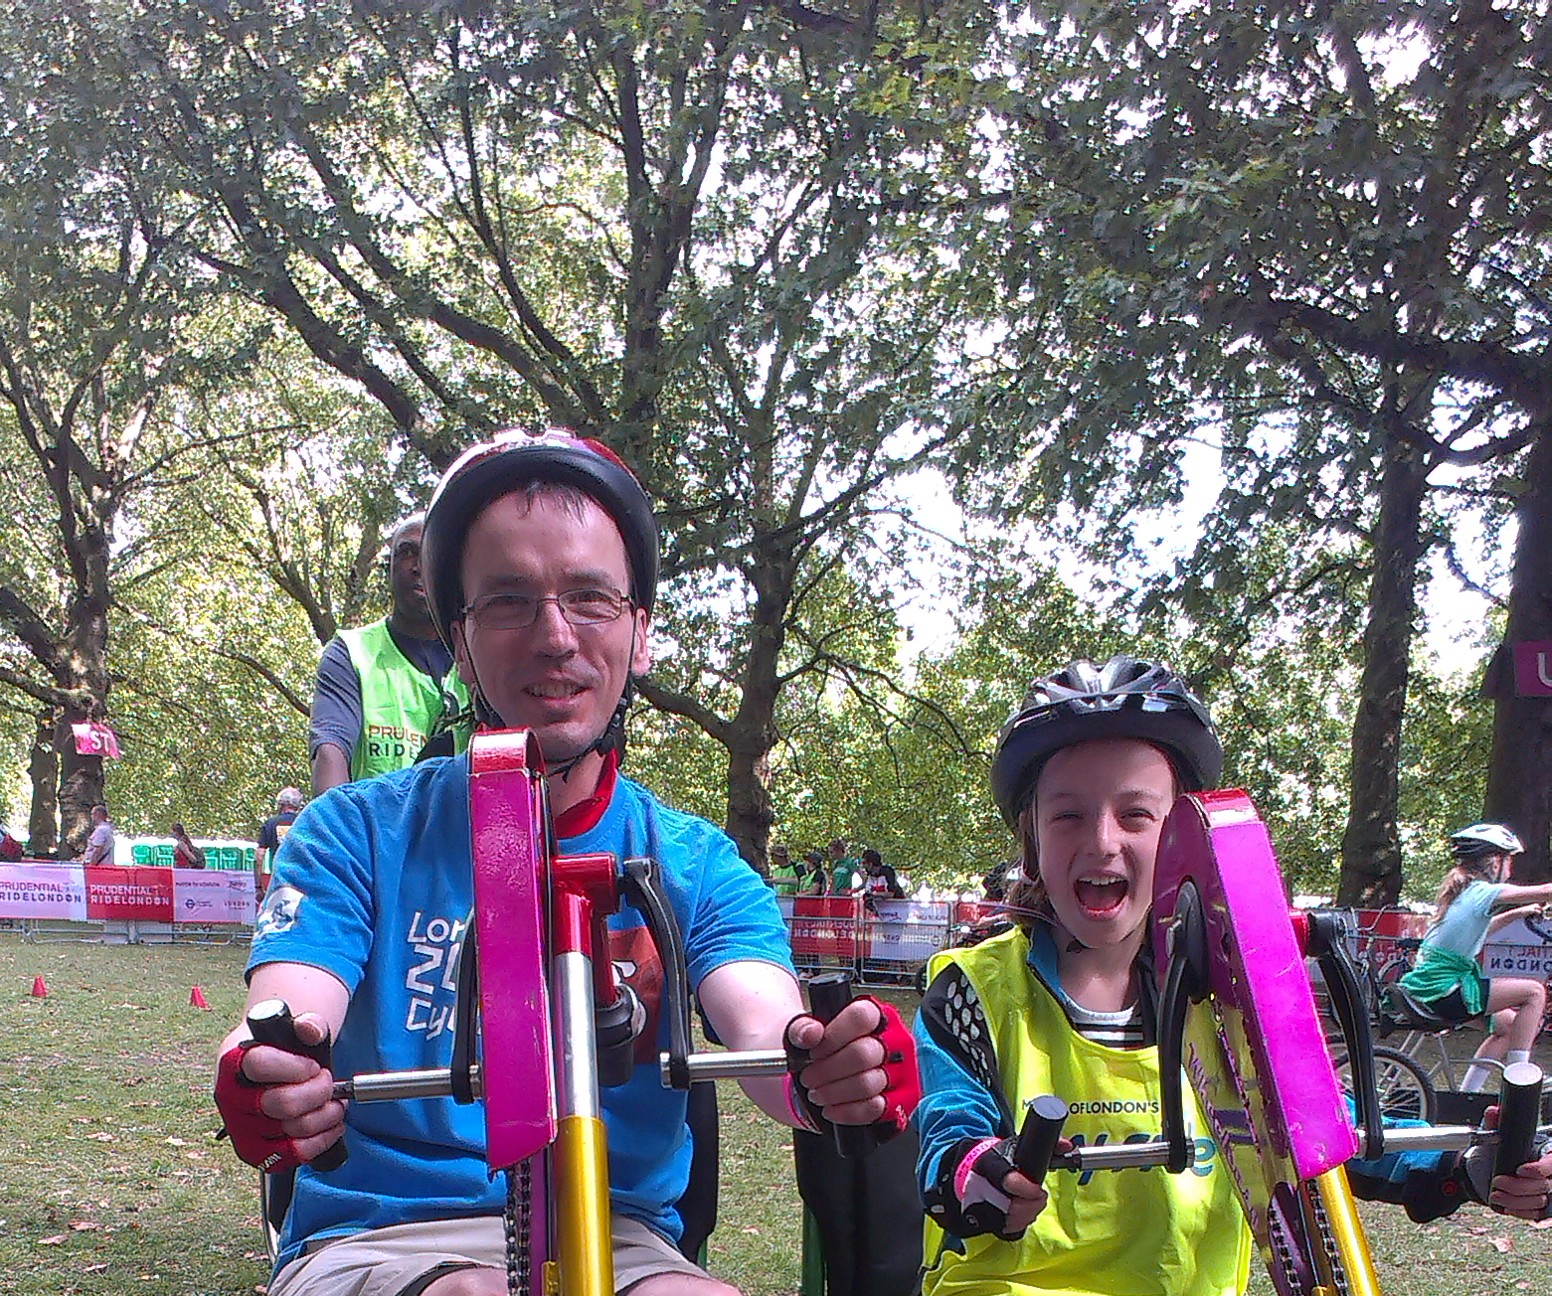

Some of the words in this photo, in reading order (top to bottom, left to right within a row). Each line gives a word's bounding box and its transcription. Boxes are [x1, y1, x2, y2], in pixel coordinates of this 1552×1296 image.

[0, 881, 63, 893] PRUDENTIAL
[90, 884, 153, 895] PRUDENTIAL
[0, 891, 82, 903] RIDELONDON
[90, 894, 170, 906] RIDELONDON
